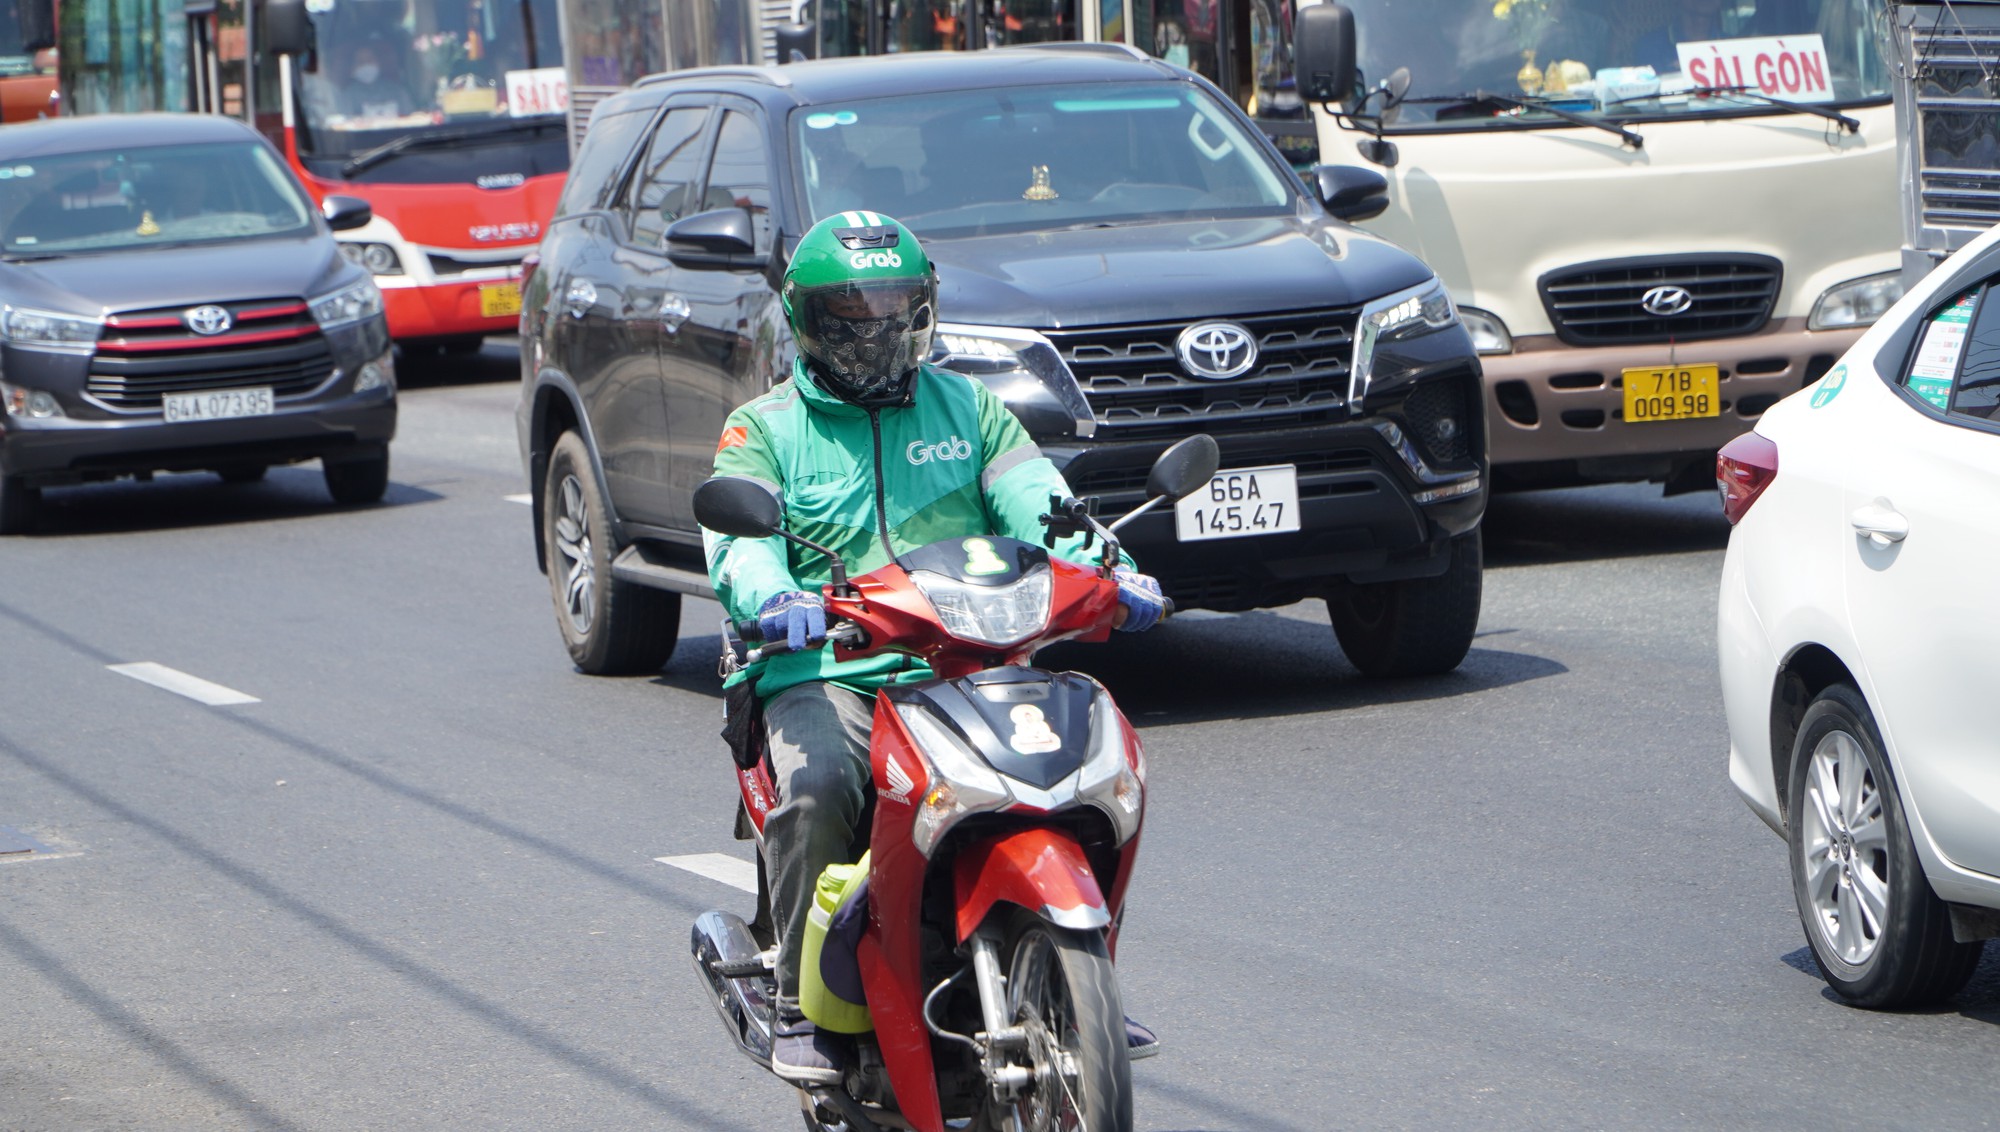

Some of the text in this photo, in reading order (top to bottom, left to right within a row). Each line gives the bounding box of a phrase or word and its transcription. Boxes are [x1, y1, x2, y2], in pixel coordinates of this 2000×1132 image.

[1688, 40, 1826, 99] SÀI GÒN
[849, 248, 902, 270] Grab
[1651, 371, 1691, 394] 71B
[1635, 394, 1709, 418] 009.98
[906, 435, 972, 466] Grab
[1210, 474, 1261, 502] 66A
[1194, 502, 1284, 534] 145.47
[877, 787, 912, 806] HONDA
